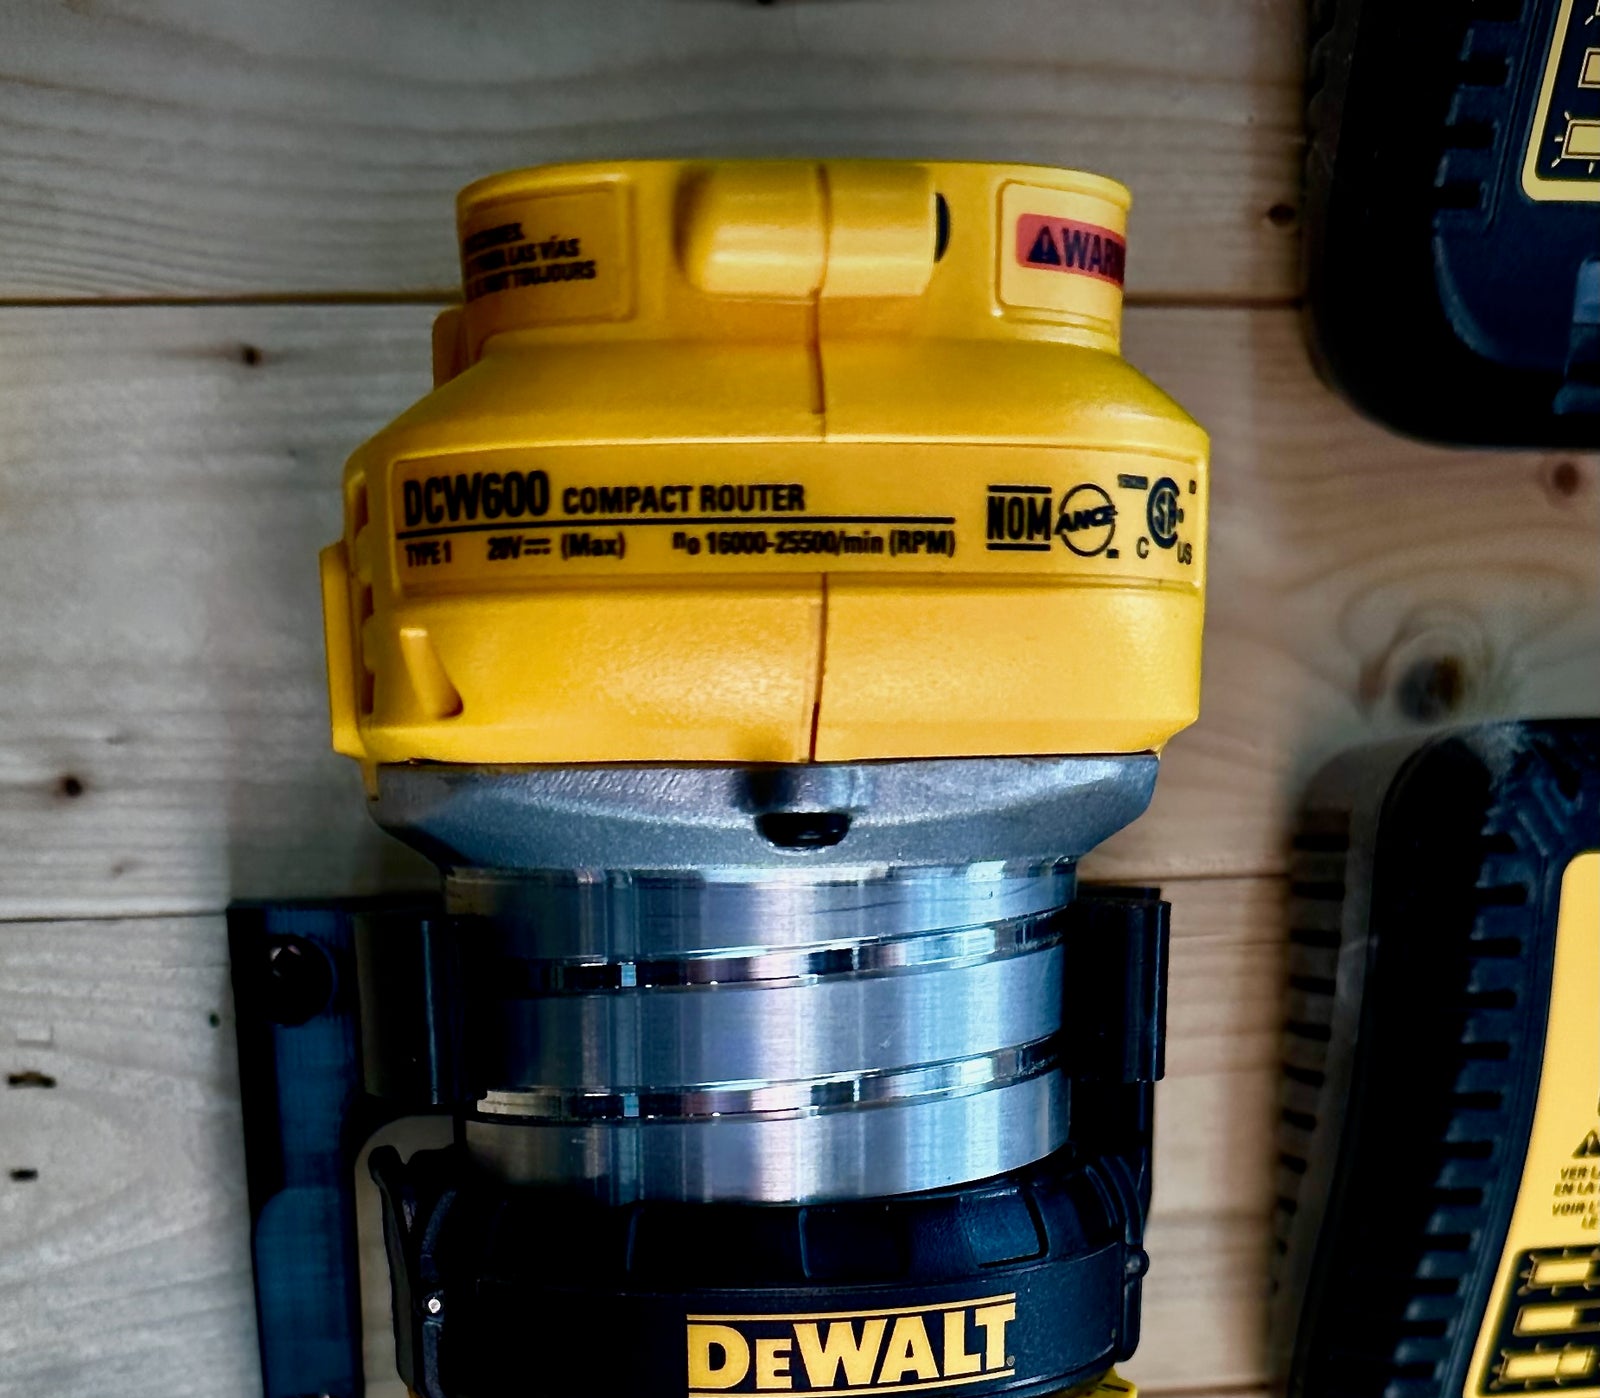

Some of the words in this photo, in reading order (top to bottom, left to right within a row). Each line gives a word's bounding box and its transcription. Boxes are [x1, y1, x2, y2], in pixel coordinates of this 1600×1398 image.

[403, 470, 550, 527] DCW600
[562, 484, 693, 515] COMPACT
[700, 483, 806, 513] ROUTER
[986, 495, 1052, 541] NOM
[405, 541, 441, 567] TYPE
[561, 531, 626, 561] (Max)
[889, 529, 956, 558] (RPM)
[1177, 541, 1193, 566] US
